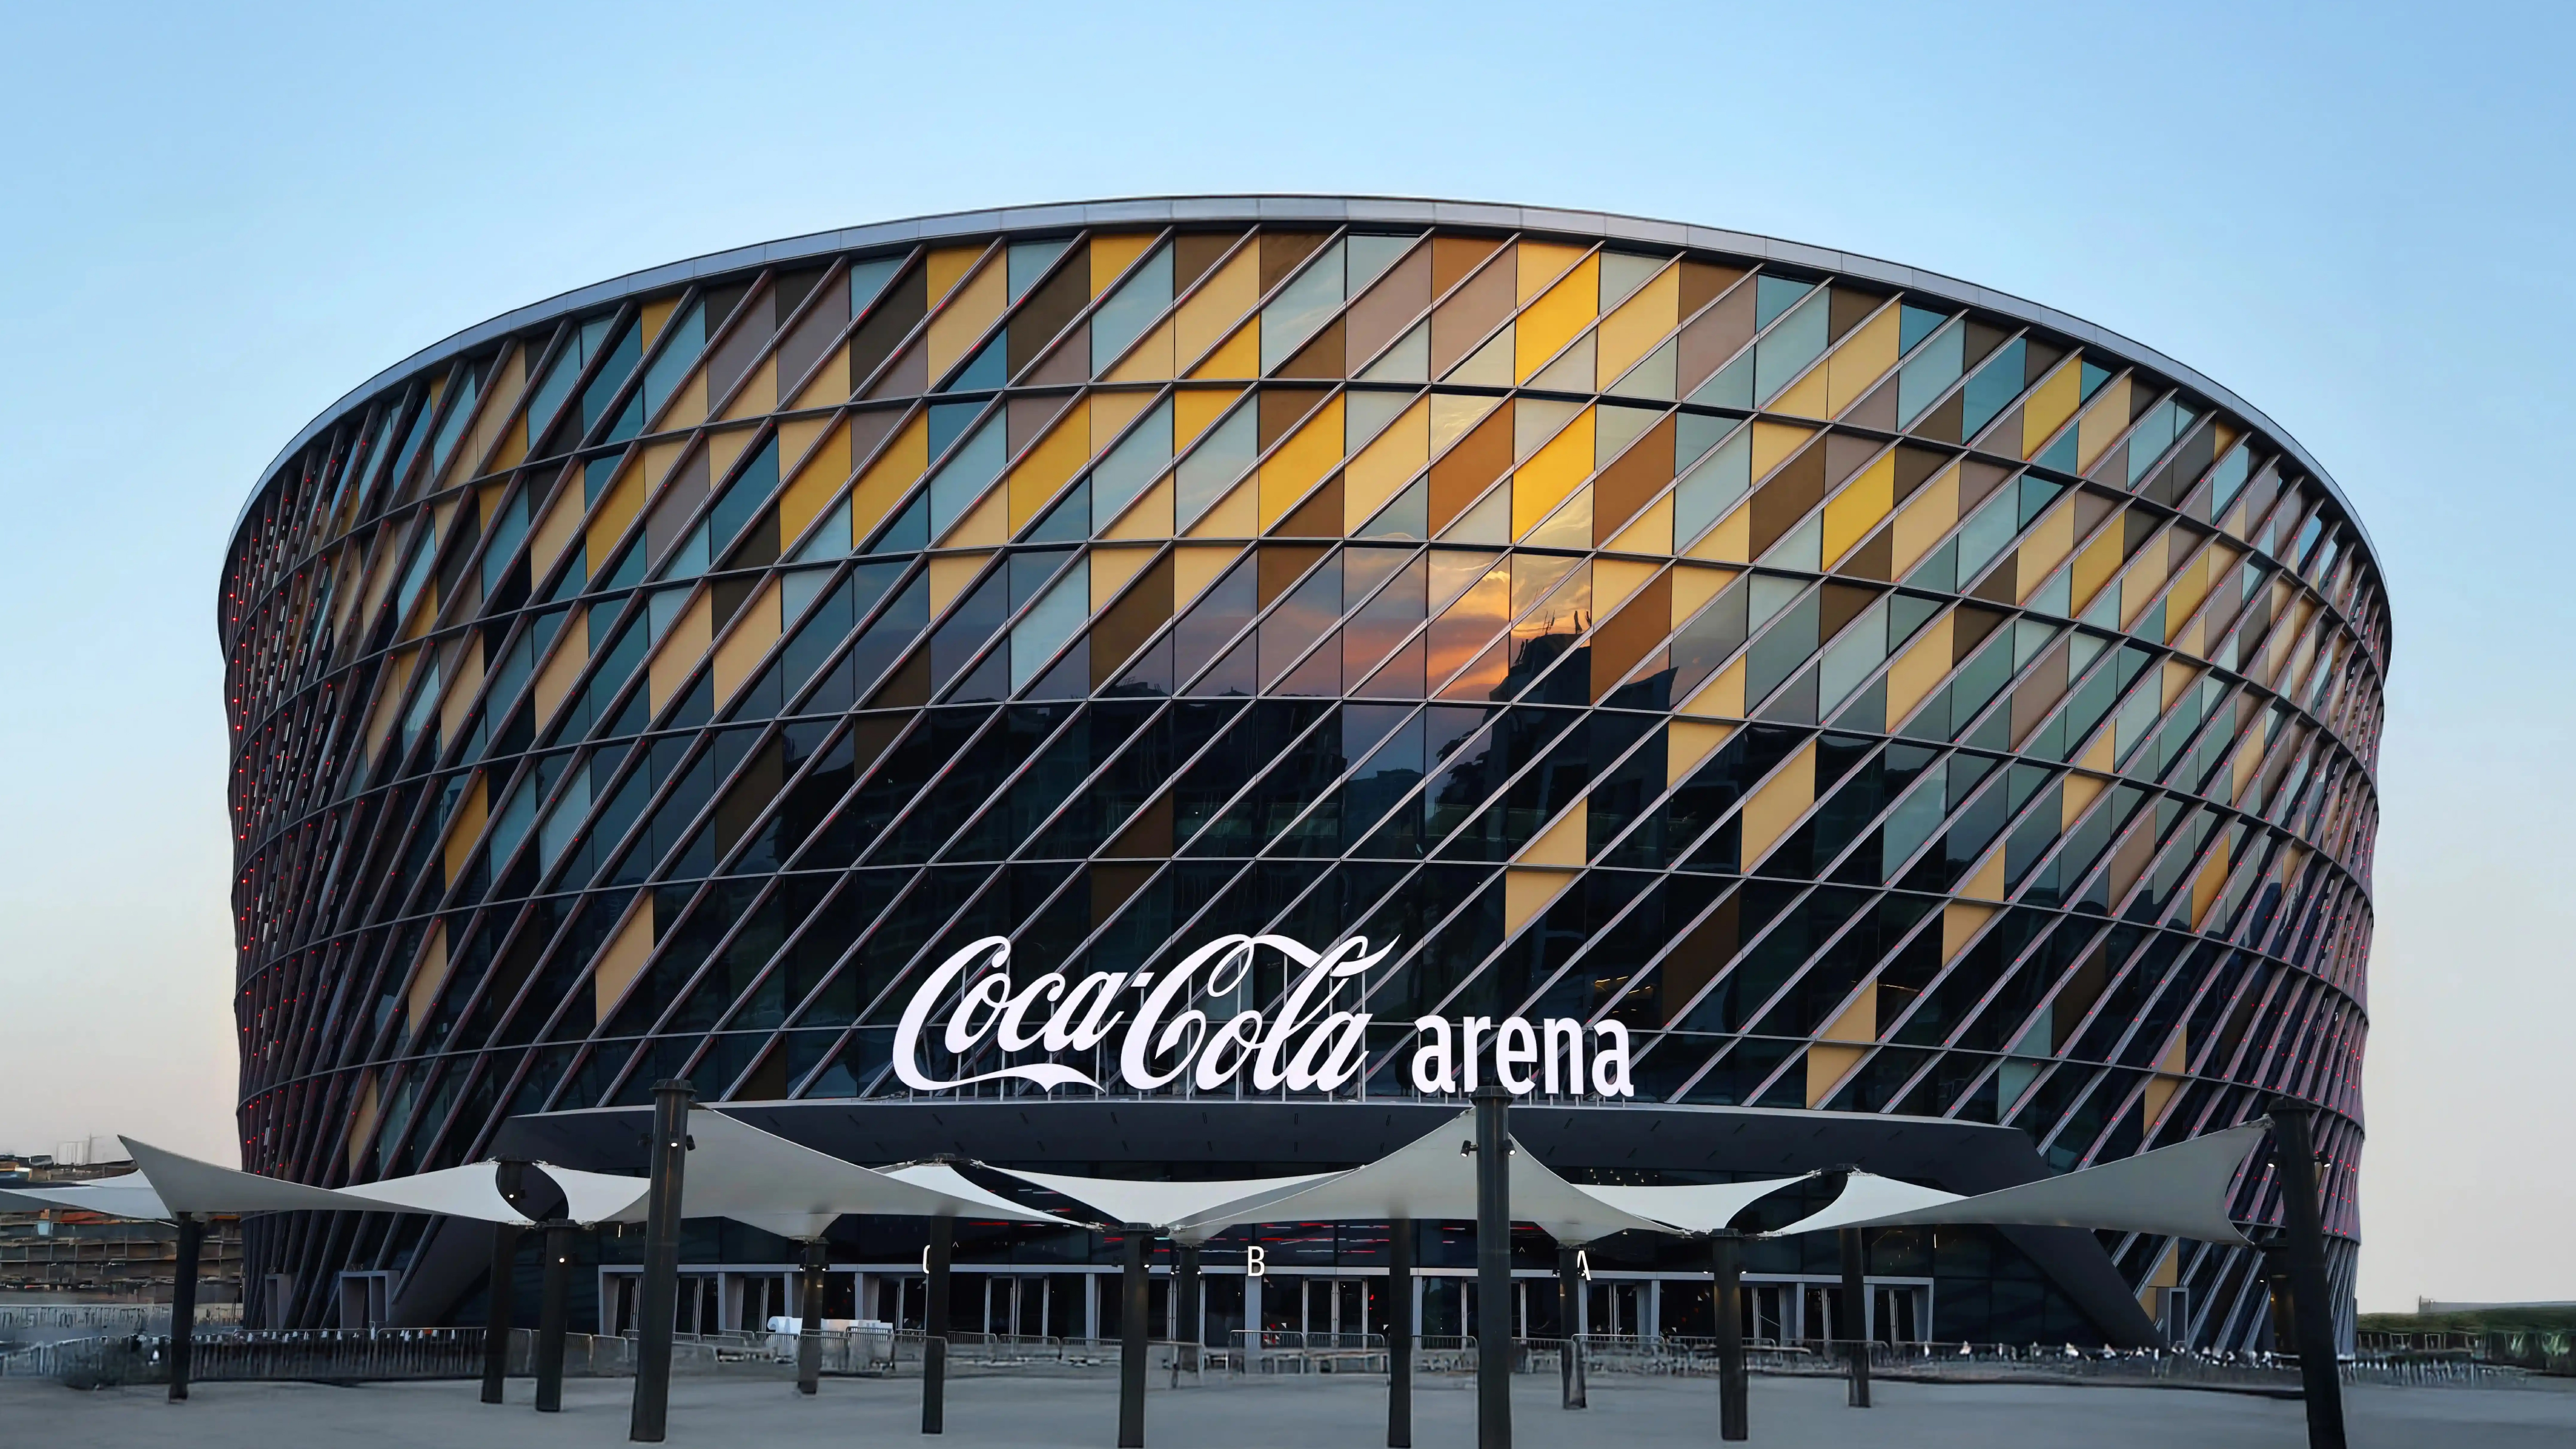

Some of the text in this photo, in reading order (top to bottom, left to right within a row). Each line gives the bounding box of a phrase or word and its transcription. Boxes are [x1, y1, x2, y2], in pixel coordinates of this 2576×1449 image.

[893, 934, 1634, 1097] Coca-Cola arena
[1248, 1246, 1265, 1276] B
